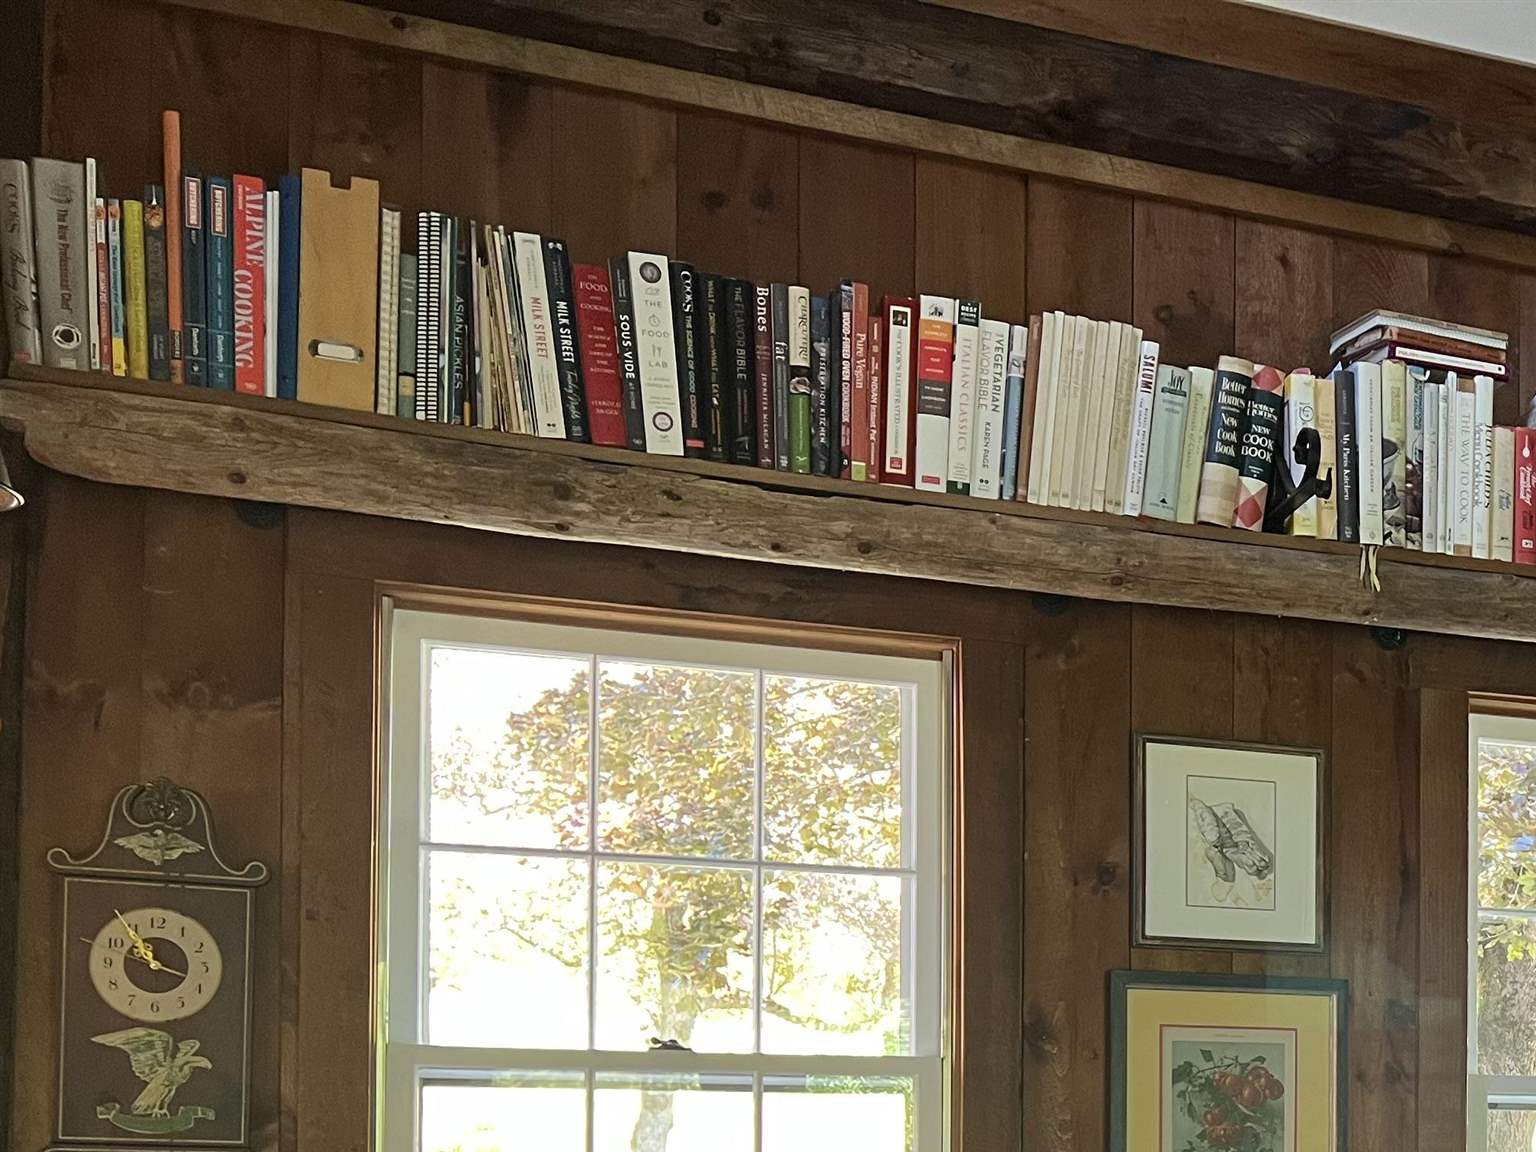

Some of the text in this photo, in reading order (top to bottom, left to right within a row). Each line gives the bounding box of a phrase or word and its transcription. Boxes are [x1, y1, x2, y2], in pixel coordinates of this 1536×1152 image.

[56, 209, 69, 224] The
[58, 243, 71, 291] Professional
[234, 187, 265, 369] ALPINE COOKING
[579, 281, 609, 293] FOOD
[58, 292, 72, 311] Chef
[530, 297, 545, 320] MILK
[644, 299, 662, 309] THE
[756, 286, 770, 332] Bones
[556, 301, 571, 325] MILK
[619, 313, 633, 348] SOUS
[641, 328, 670, 338] FOOD
[734, 286, 747, 381] THE FLAVOR BIBLE
[453, 295, 465, 390] ASIAN PICKLES
[533, 324, 549, 359] STREET
[559, 327, 575, 363] STREET
[685, 330, 694, 358] SCIENCE
[775, 341, 789, 361] fat
[624, 351, 636, 379] VIDE
[648, 359, 668, 369] LAB
[841, 311, 851, 423] WOOD-FIRED OVEN COOKBOOK
[854, 333, 866, 389] Pure Vegan
[977, 330, 993, 411] FLAVOR BIBLE
[688, 371, 697, 394] GOOD
[991, 344, 1004, 413] VEGETARIAN
[1140, 355, 1156, 394] SALUMI
[1167, 369, 1185, 391] JOY
[819, 347, 827, 443] PRESERVATION KITCHEN
[870, 376, 878, 403] INDIAN
[956, 338, 973, 452] ITALIAN CLASSICS
[1222, 377, 1246, 395] Better
[1218, 391, 1246, 409] Homes
[1247, 400, 1275, 414] Better
[1221, 412, 1239, 428] New
[869, 429, 878, 443] Pot
[1216, 427, 1238, 443] Cook
[1251, 424, 1271, 436] NEW
[981, 422, 992, 470] KAREN PAGE
[1215, 441, 1236, 457] Book
[1243, 433, 1275, 451] COOK
[1241, 445, 1273, 463] BOOK
[1340, 433, 1351, 501] My Paris Kitchen
[1460, 414, 1471, 524] THE WAY TO COOK
[1473, 423, 1484, 507] Menu Cookbook
[149, 916, 167, 929] 12
[179, 926, 186, 938] 1
[107, 937, 124, 949] 10
[193, 942, 205, 953] 2
[103, 957, 113, 969] 9
[200, 962, 210, 974] 3
[108, 980, 119, 991] 8
[194, 983, 203, 995] 4
[127, 995, 137, 1007] 7
[150, 1001, 160, 1013] 6
[176, 997, 186, 1009] 5
